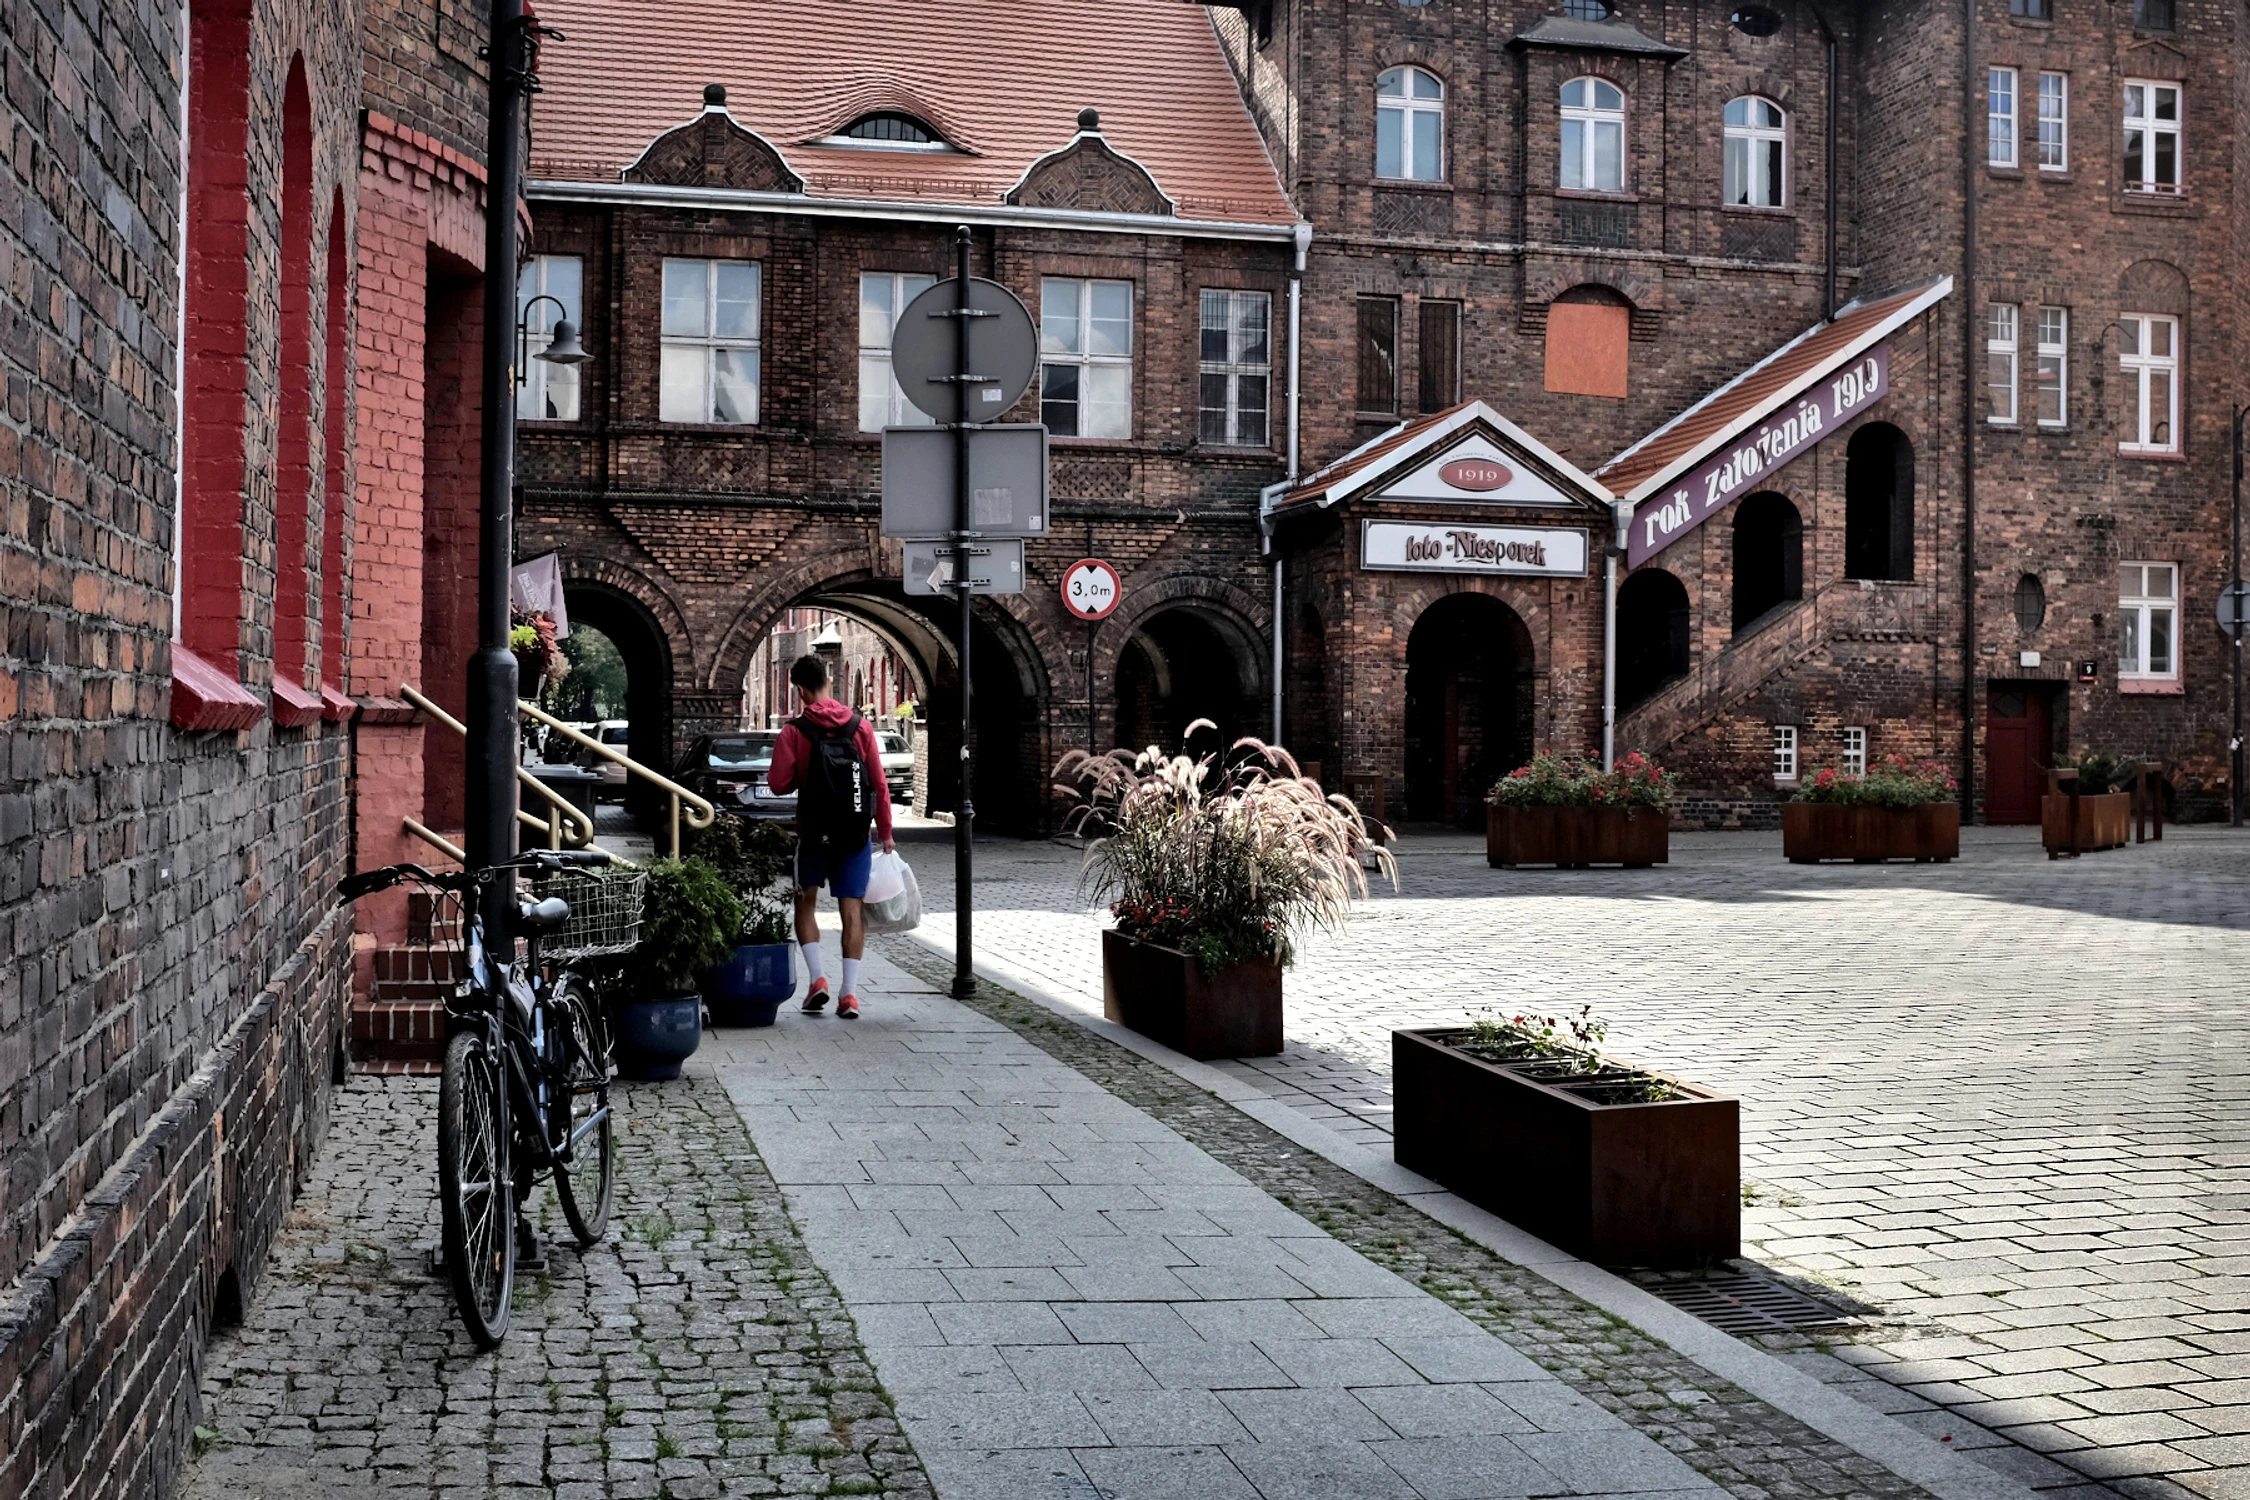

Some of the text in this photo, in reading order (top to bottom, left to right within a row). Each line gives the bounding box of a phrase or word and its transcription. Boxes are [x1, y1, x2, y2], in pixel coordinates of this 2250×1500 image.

[1645, 358, 1879, 548] rok założenia 1919
[1458, 468, 1497, 482] 1919
[1447, 531, 1546, 566] Niesporek
[853, 771, 862, 812] KELME
